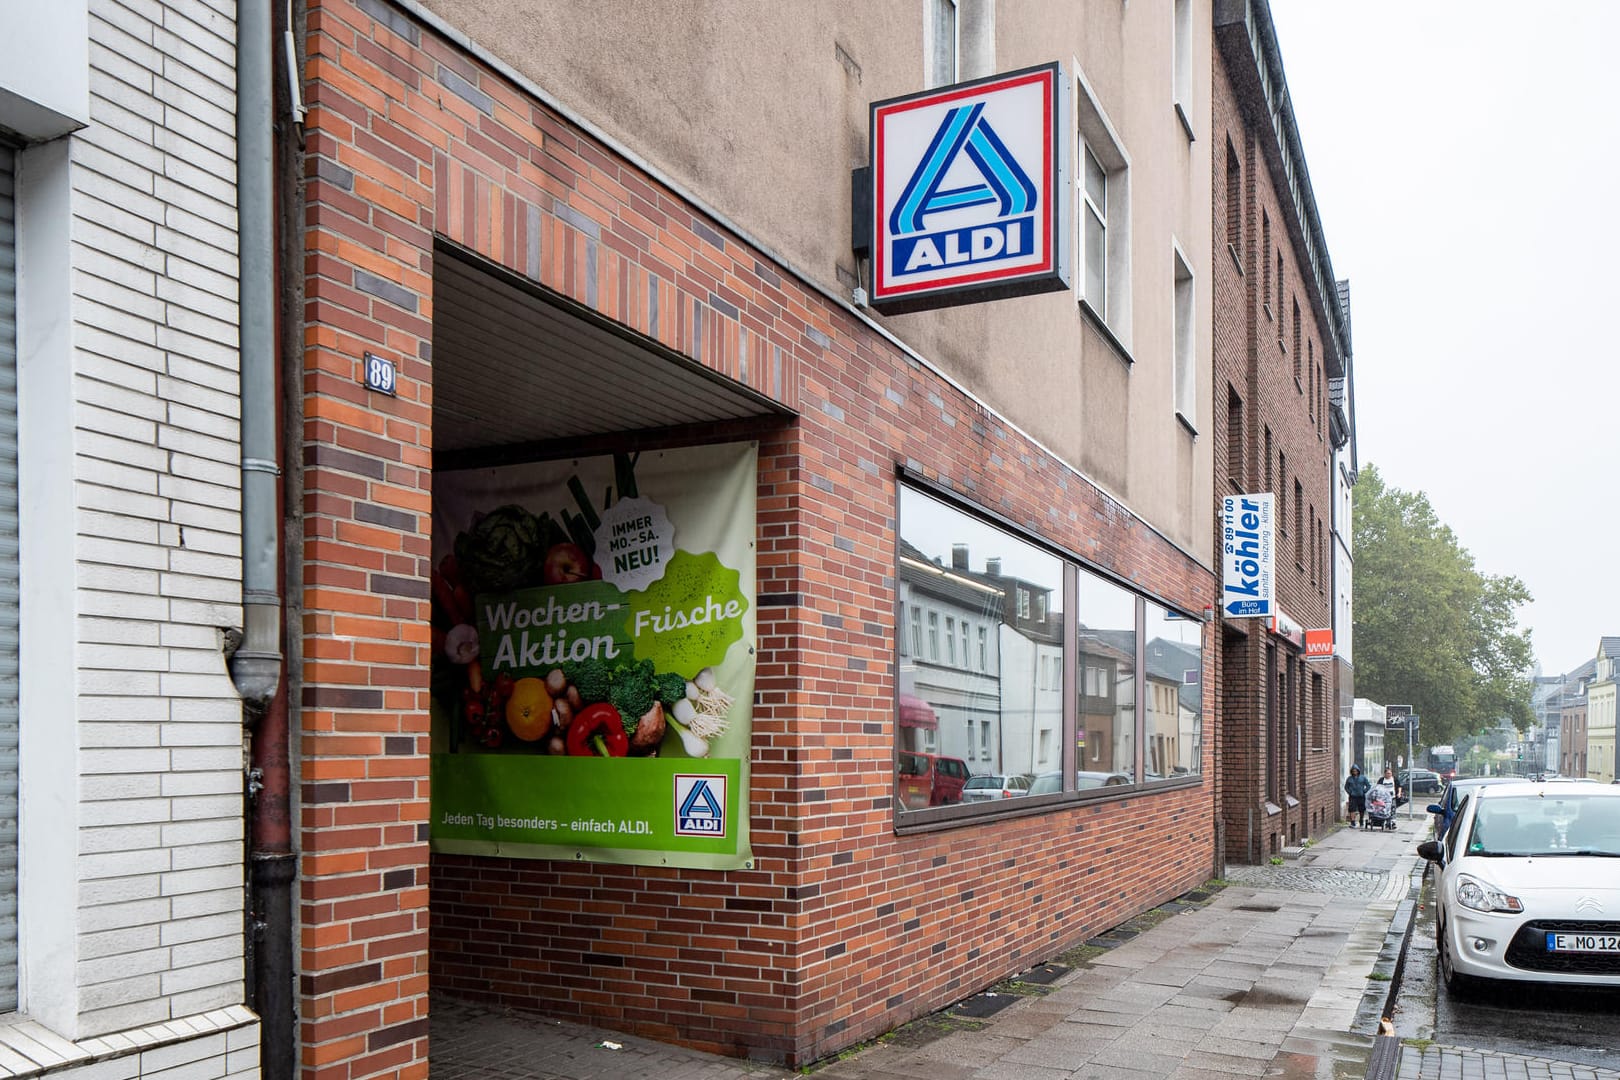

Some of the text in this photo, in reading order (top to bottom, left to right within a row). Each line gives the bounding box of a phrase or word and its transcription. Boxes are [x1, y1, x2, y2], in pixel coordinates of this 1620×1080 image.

[904, 222, 1021, 272] ALDI
[370, 359, 392, 390] 89
[612, 515, 652, 537] IMMER
[1225, 498, 1234, 541] 89 11 00
[1261, 501, 1269, 523] klima
[614, 544, 660, 574] NEU!
[1225, 498, 1259, 597] köhler
[1261, 530, 1270, 563] heizung
[485, 596, 620, 632] Wochen-
[635, 595, 742, 637] Frische
[492, 629, 620, 670] Aktion
[441, 811, 474, 826] Jeden
[476, 813, 495, 830] Tag
[497, 814, 558, 830] besonders
[570, 818, 615, 833] einfach
[618, 820, 653, 835] ALDI.
[684, 819, 719, 831] ALDI
[1557, 936, 1566, 949] E
